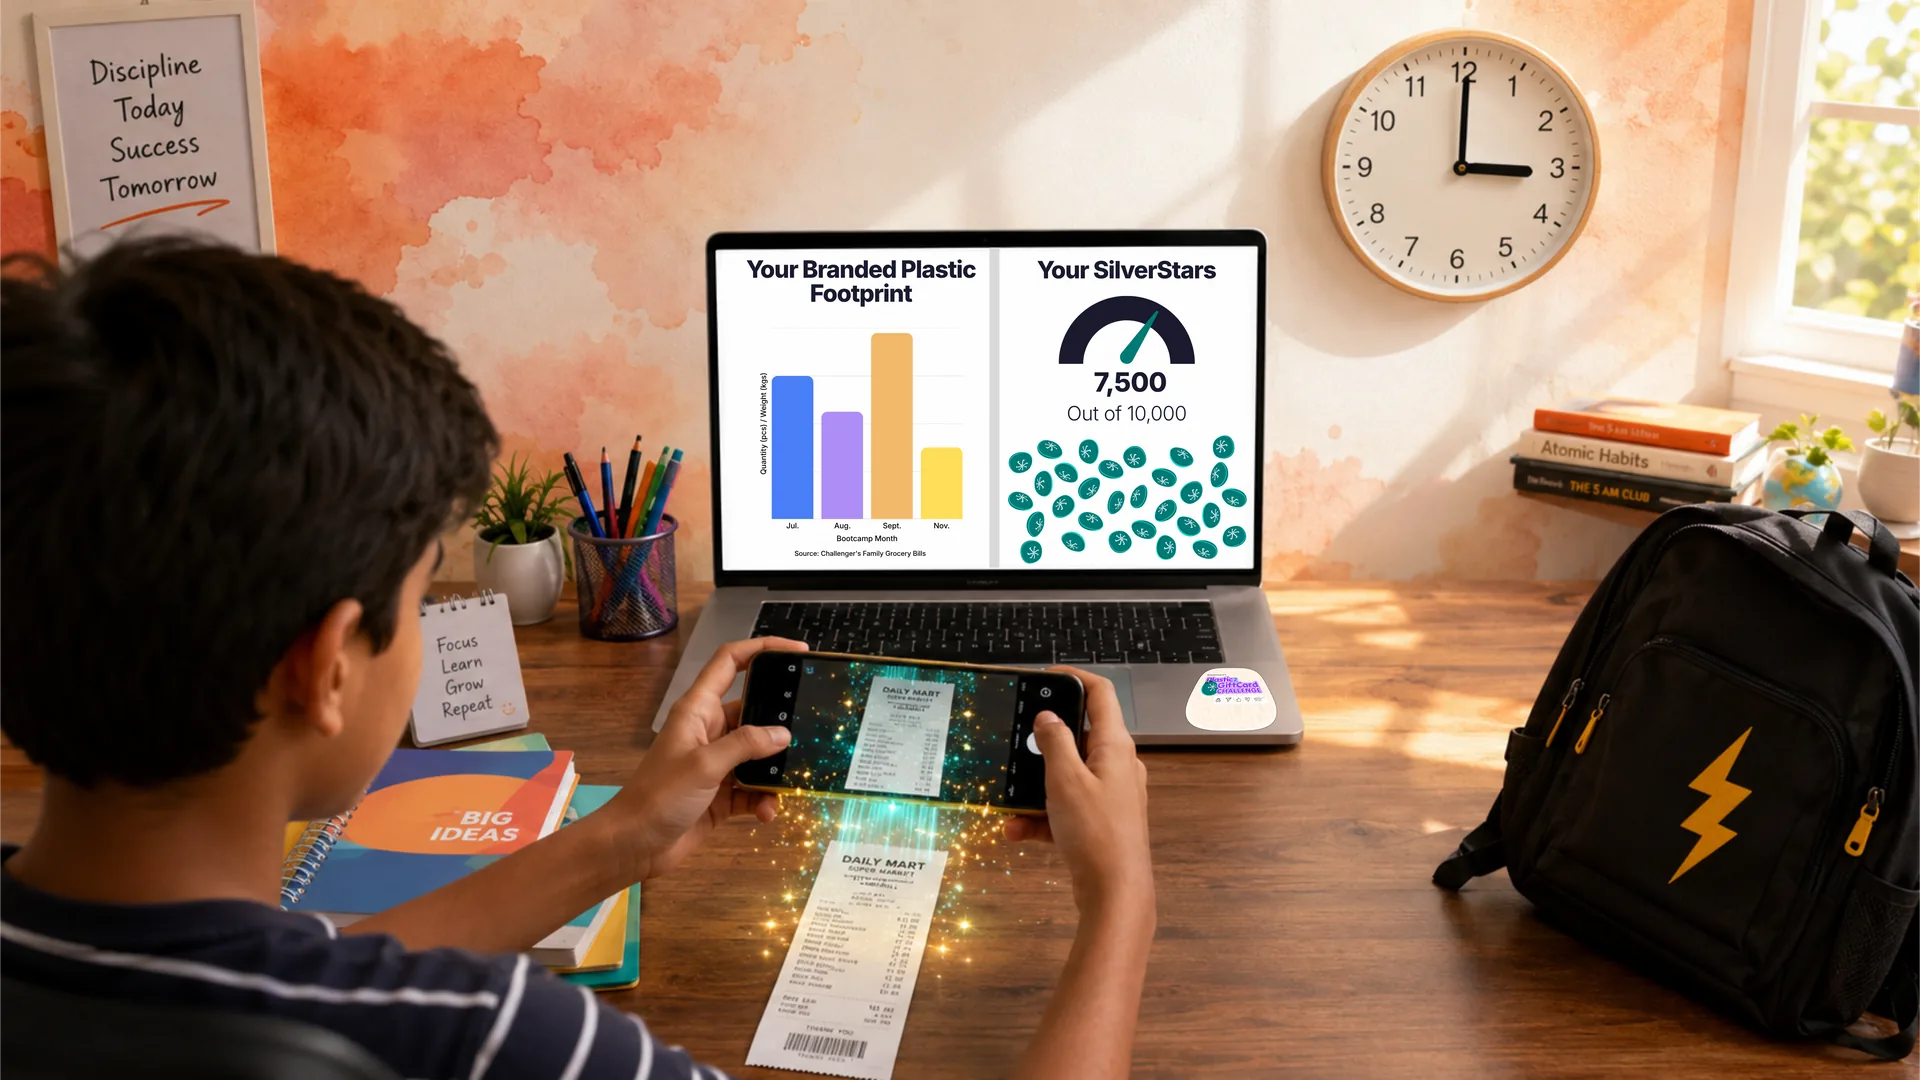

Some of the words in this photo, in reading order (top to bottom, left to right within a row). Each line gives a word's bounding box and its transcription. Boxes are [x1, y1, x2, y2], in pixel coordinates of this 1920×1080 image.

[90, 53, 202, 89] Discipline
[1451, 61, 1477, 83] 12
[1405, 75, 1425, 98] 11
[1508, 75, 1517, 97] 1
[113, 93, 184, 127] Today
[1370, 109, 1396, 132] 10
[1538, 110, 1554, 132] 2
[110, 136, 200, 163] Success
[1357, 156, 1373, 178] 9
[1550, 157, 1565, 179] 3
[100, 171, 217, 202] Tomorrow
[1370, 202, 1385, 224] 8
[1533, 203, 1549, 224] 4
[1404, 236, 1419, 257] 7
[1498, 236, 1513, 258] 5
[747, 260, 798, 278] Your
[803, 260, 896, 278] Branded
[902, 259, 977, 278] Plastic
[1038, 261, 1090, 279] Your
[1093, 260, 1217, 279] SilverStars
[1450, 248, 1465, 270] 6
[810, 283, 912, 307] Footprint
[759, 372, 768, 391] (kgs)
[1094, 371, 1167, 398] 7,500
[759, 392, 768, 417] Weight
[1067, 405, 1099, 422] Out
[1104, 405, 1122, 422] of
[1127, 405, 1187, 424] 10,000
[759, 424, 768, 443] (pcs)
[759, 444, 768, 475] Quantity
[1541, 439, 1595, 461] Atomic
[1599, 448, 1650, 469] Habits
[1569, 480, 1590, 494] THE
[1593, 483, 1600, 495] 5
[1602, 486, 1620, 498] AM
[1622, 488, 1651, 503] CLUB
[786, 522, 800, 530] Jul.
[833, 522, 851, 531] Aug.
[882, 522, 902, 531] Sept.
[933, 522, 950, 530] Nov.
[836, 534, 874, 543] Bootcamp
[875, 534, 898, 542] Month
[820, 550, 861, 558] Challenger's
[862, 550, 884, 558] Family
[885, 550, 912, 558] Grocery
[436, 636, 479, 654] Focus
[441, 657, 483, 675] Learn
[445, 678, 485, 696] Grow
[1218, 681, 1259, 689] GiftCard
[442, 694, 494, 721] Repeat
[460, 811, 513, 825] BIG
[430, 827, 519, 842] IDEAS
[842, 855, 882, 866] DAILY
[885, 859, 926, 870] MART
